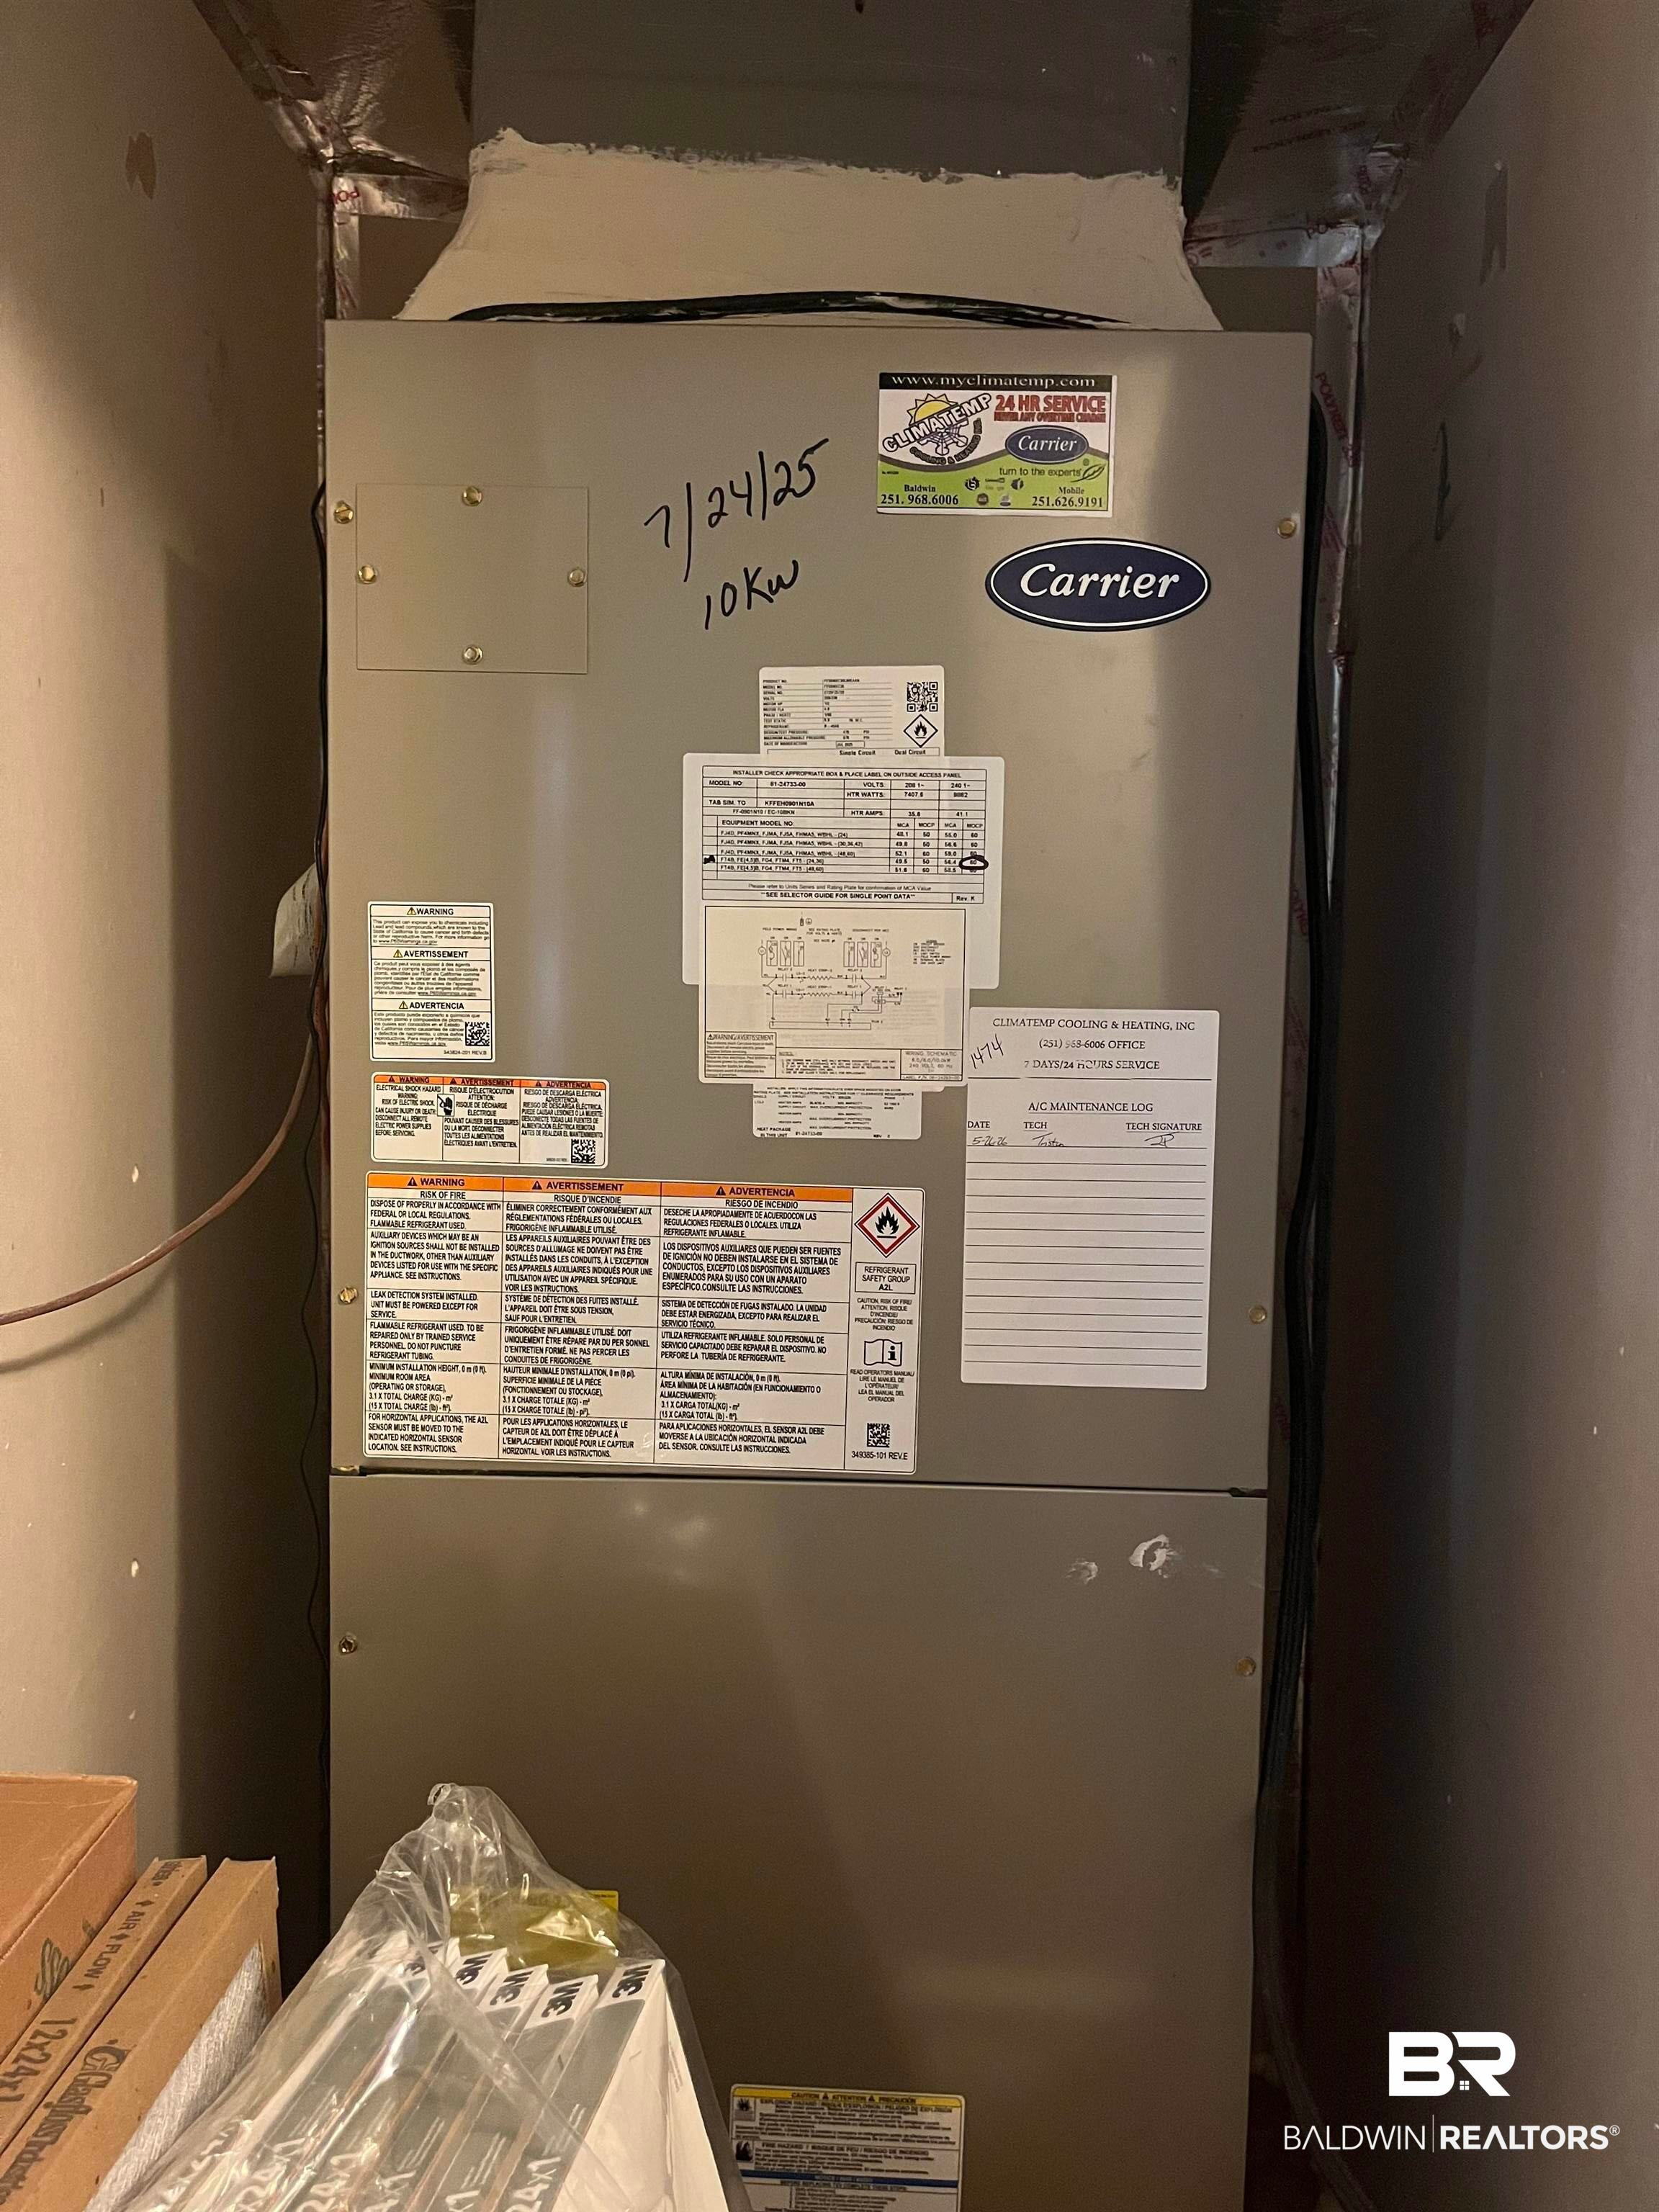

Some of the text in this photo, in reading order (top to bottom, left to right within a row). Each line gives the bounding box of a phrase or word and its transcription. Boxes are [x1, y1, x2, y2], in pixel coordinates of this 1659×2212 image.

[892, 377, 1094, 386] www.myclimatemp.com
[994, 394, 1106, 413] 24 HR SERVICE
[883, 393, 992, 452] CLIMATEMP
[1018, 436, 1077, 451] Carrier
[999, 467, 1017, 475] turn
[1019, 467, 1028, 476] to
[1048, 467, 1082, 477] experts
[904, 484, 935, 493] Baldwin
[881, 493, 958, 505] 251. 968.6006
[1031, 495, 1102, 507] 251.626.9191
[1020, 562, 1179, 599] Carrier
[992, 1017, 1195, 1030] CLIMATEMP COOLING & HEATING, INC
[1039, 1038, 1062, 1048] (251)
[1107, 1040, 1145, 1048] OFFICE
[1033, 1059, 1074, 1069] DAYS/24
[1115, 1060, 1159, 1069] SERVICE
[398, 1076, 431, 1084] WARNING
[460, 1077, 515, 1087] AVERTISSEMENT
[545, 1080, 592, 1089] ADVERTENCIA
[1028, 1102, 1153, 1112] A/C MAINTENANCE LOG
[1125, 1122, 1149, 1132] TECH
[420, 1177, 464, 1186] WARNING
[546, 1181, 624, 1191] AVERTISSEMENT
[420, 1190, 466, 1200] RISK OF FIRE
[729, 1187, 795, 1197] ADVERTENCIA
[553, 1194, 621, 1205] RISQUE D'INCENDIE
[724, 1199, 799, 1210] RIESGO DE INCENDIO
[444, 1201, 485, 1210] ACCORDANCE
[369, 1219, 405, 1229] FLAMMABLE
[407, 1220, 448, 1230] REFRIGERANT
[864, 1266, 909, 1275] REFRIGERANT
[851, 1450, 886, 1459] 349385-101
[84, 1910, 145, 1979] AIR FLOW
[456, 1953, 493, 1985] 3M
[612, 1964, 652, 1998] 3M
[490, 1970, 533, 2005] 3M
[541, 1980, 583, 2018] 3M
